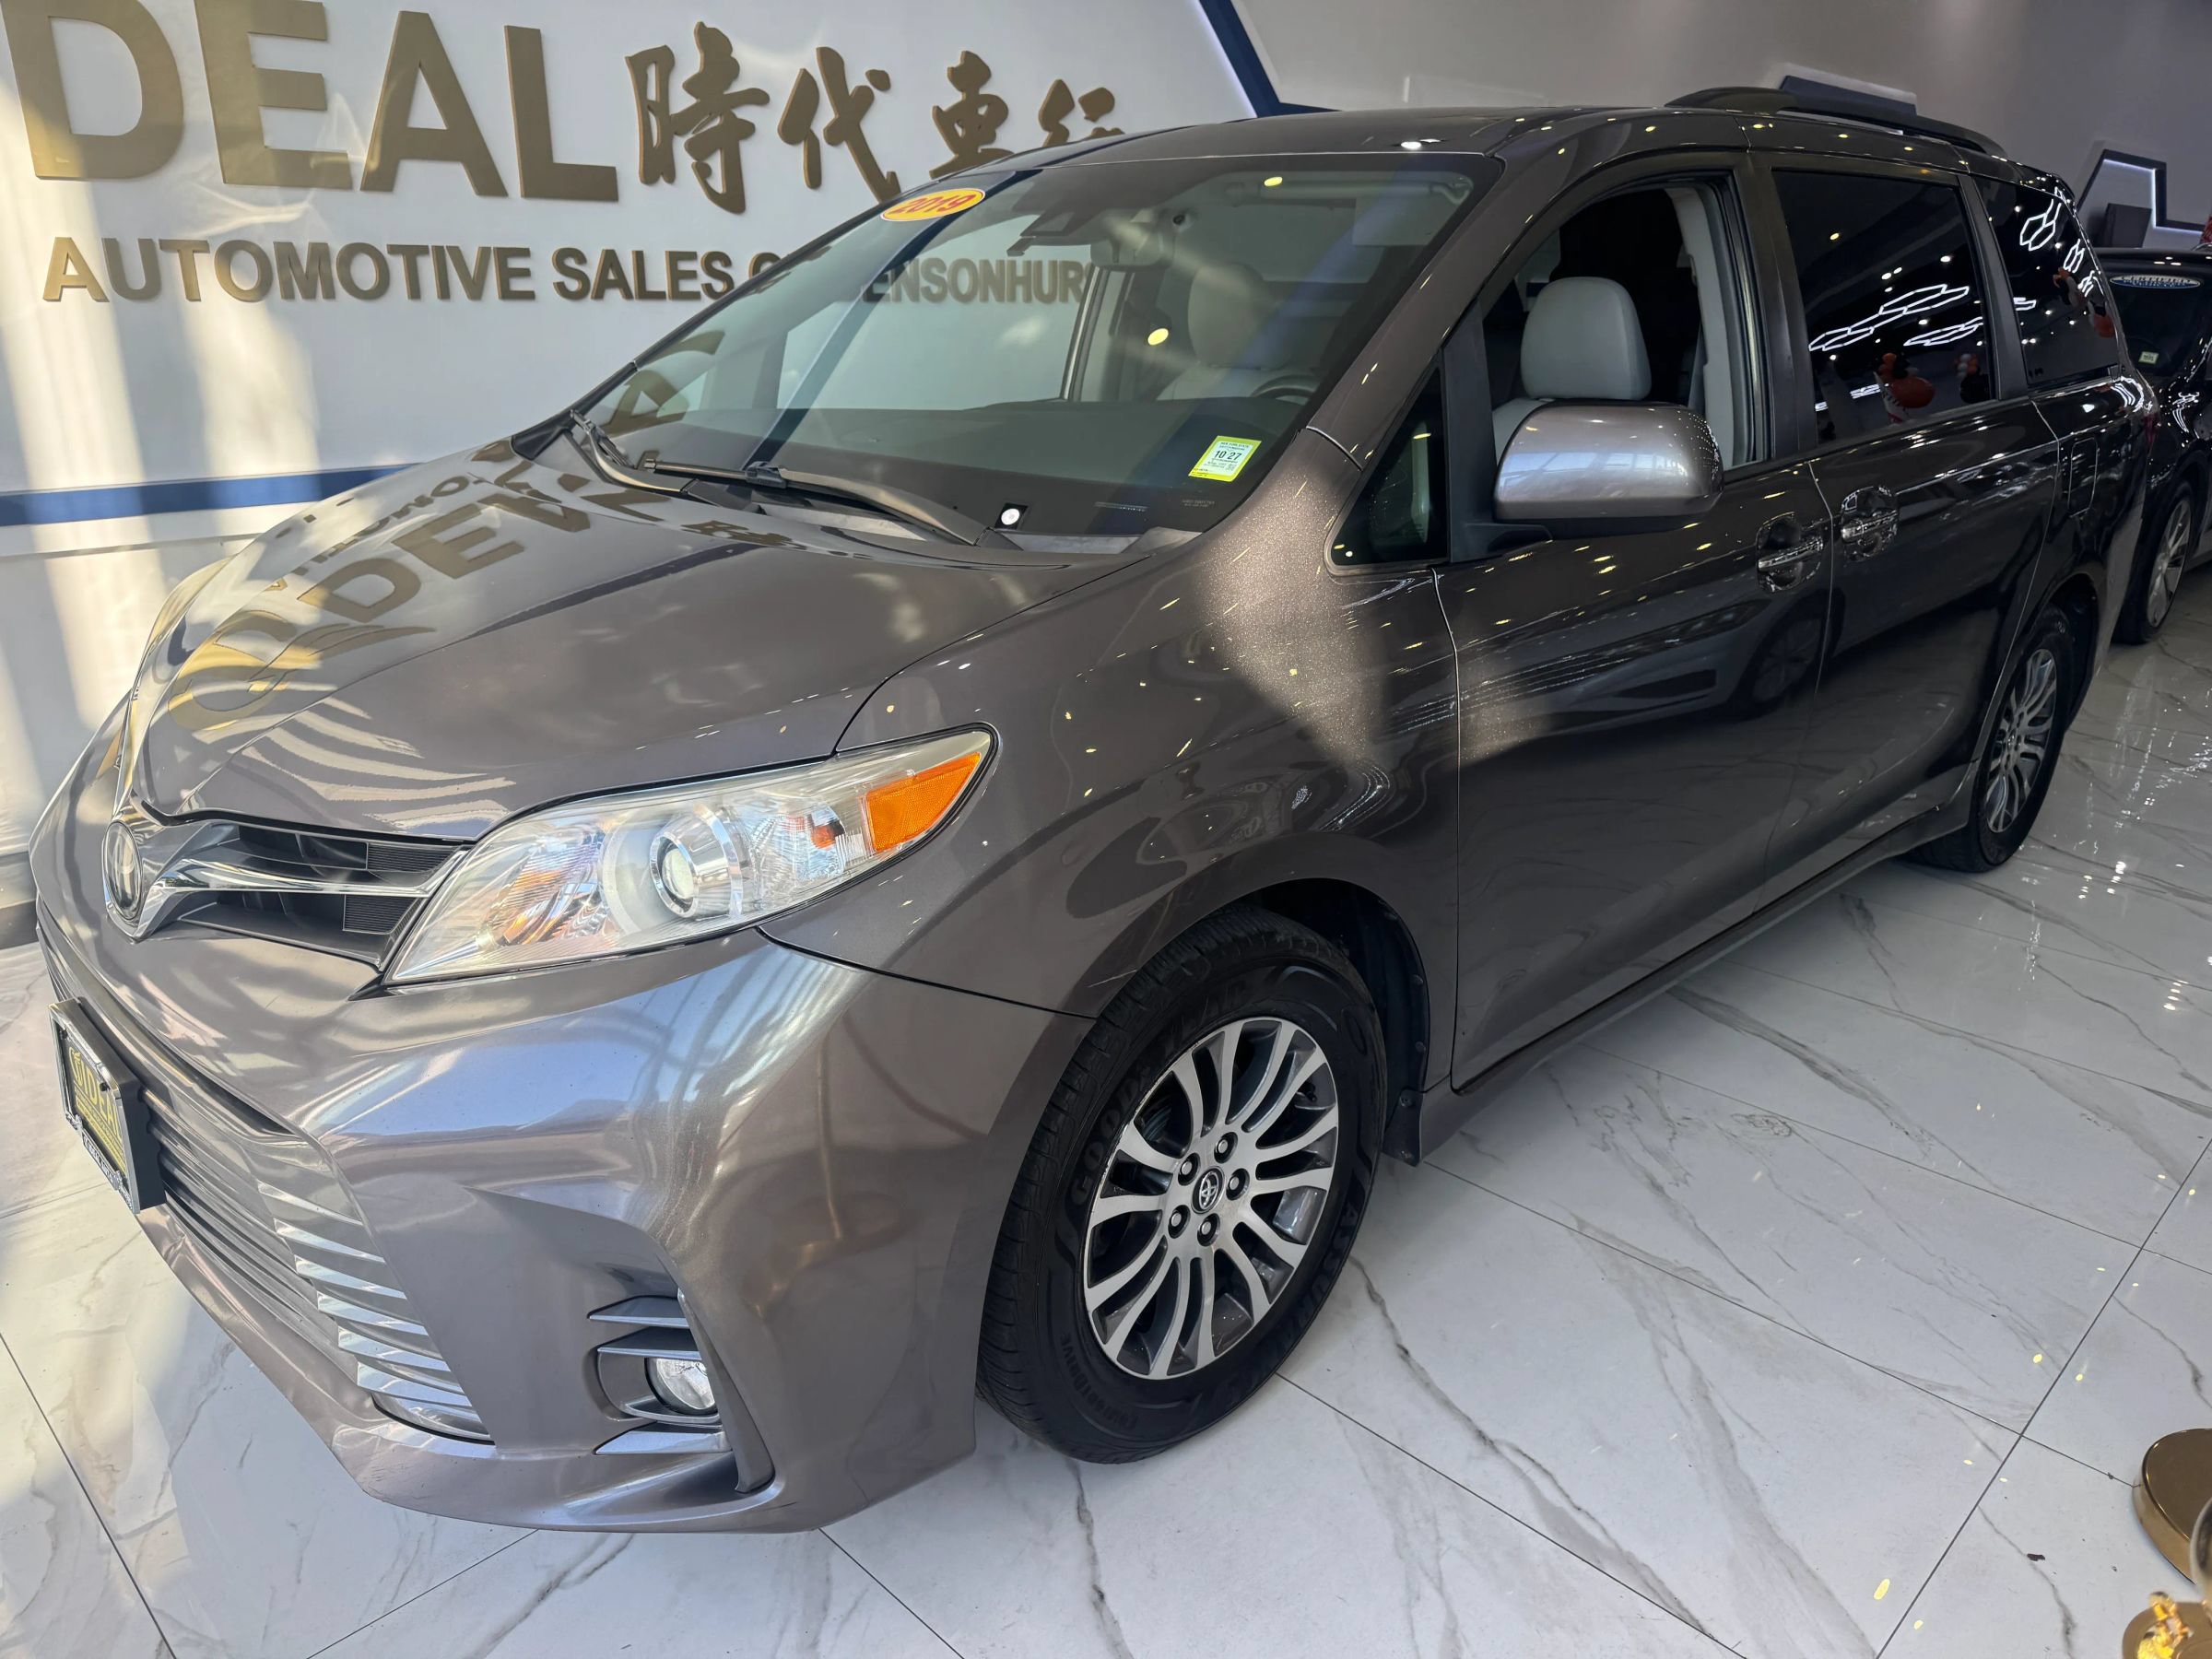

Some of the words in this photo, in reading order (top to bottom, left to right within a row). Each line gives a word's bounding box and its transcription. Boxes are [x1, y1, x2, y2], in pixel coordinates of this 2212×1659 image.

[2, 0, 618, 202] DEAL
[887, 194, 977, 215] 2019
[42, 236, 535, 302] AUTOMOTIVE
[552, 246, 734, 302] SALES
[1227, 452, 1242, 461] 27
